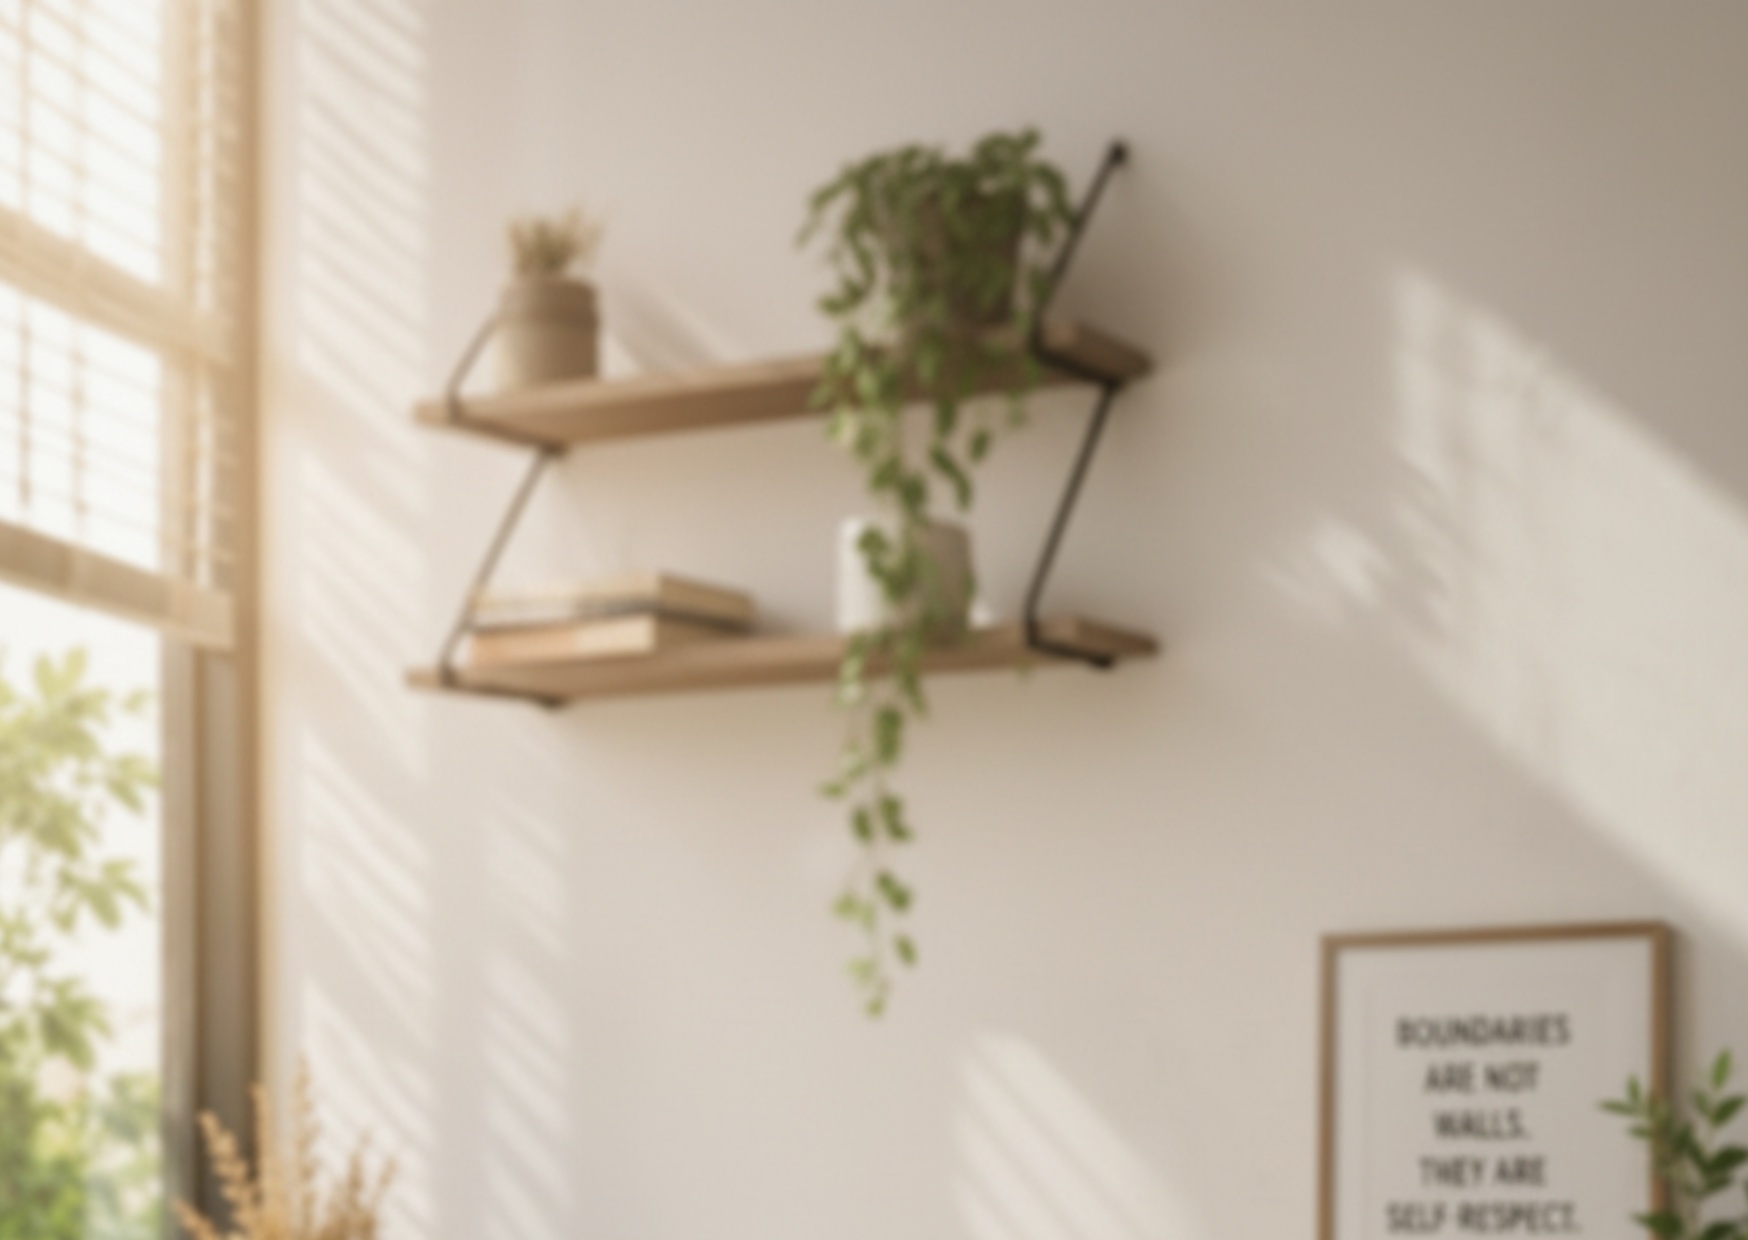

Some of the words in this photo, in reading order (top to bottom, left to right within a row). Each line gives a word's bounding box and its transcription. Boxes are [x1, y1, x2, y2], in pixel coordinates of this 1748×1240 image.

[1396, 1013, 1571, 1048] BOUNDARIES
[1424, 1062, 1475, 1094] ARE
[1484, 1061, 1539, 1093] NOT
[1419, 1156, 1484, 1188] THEY
[1494, 1156, 1547, 1188] ARE
